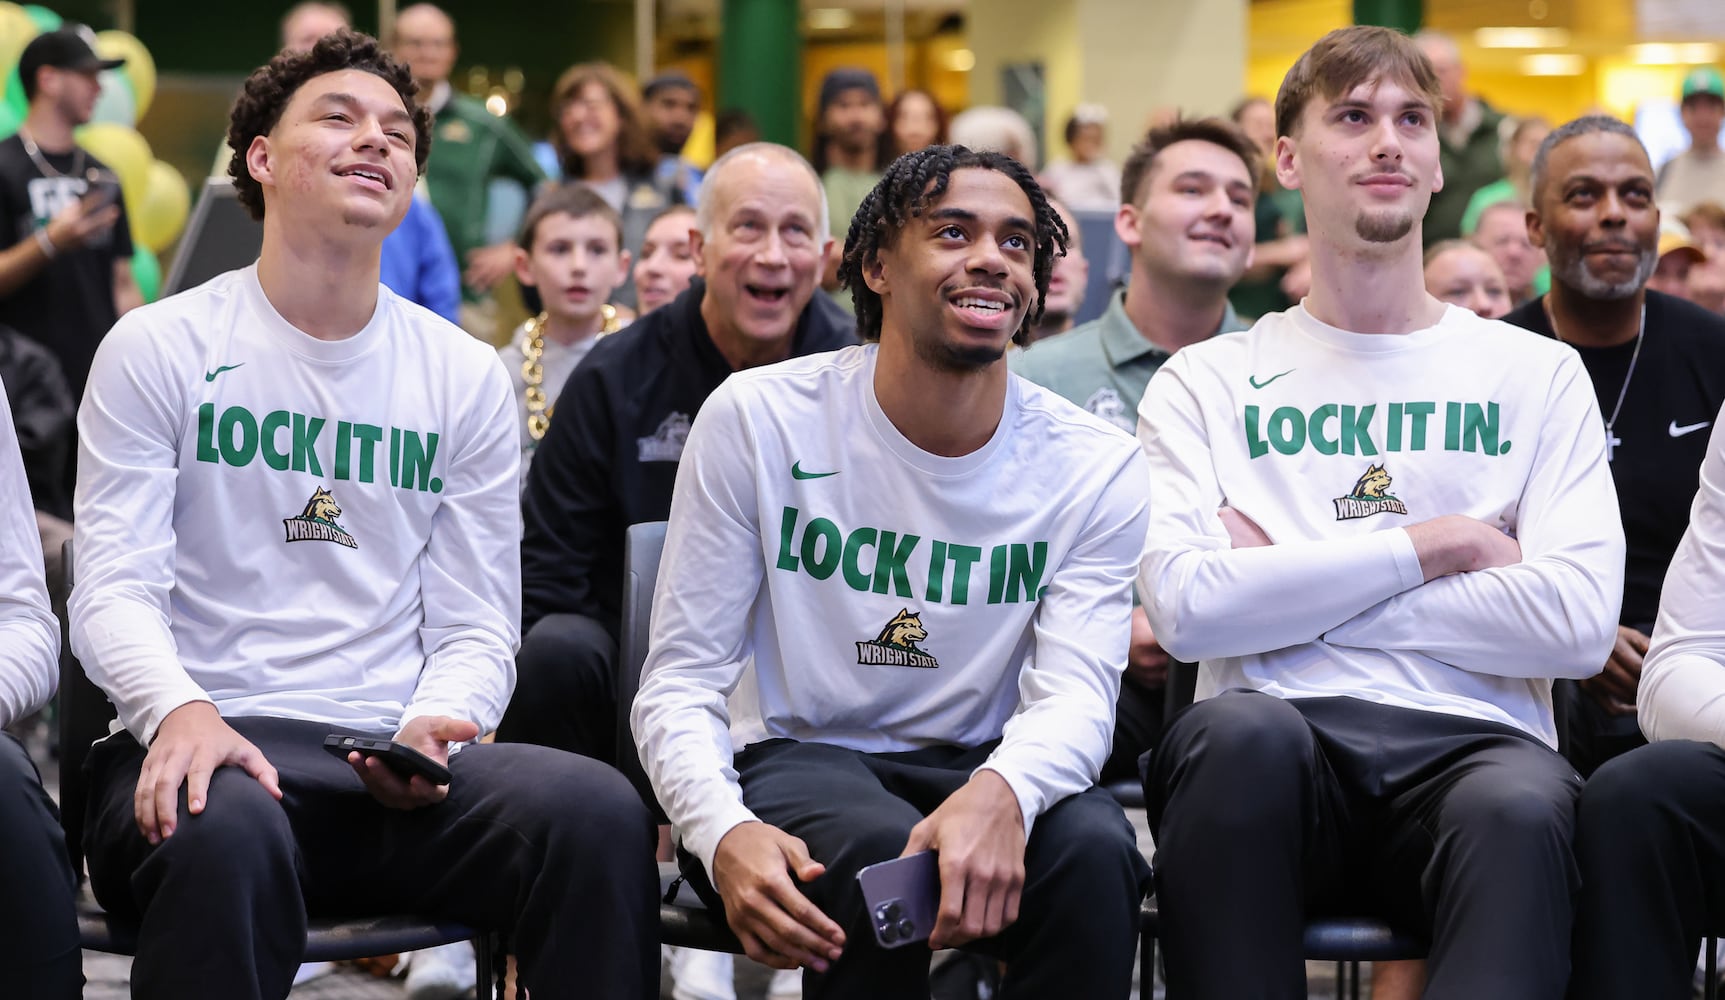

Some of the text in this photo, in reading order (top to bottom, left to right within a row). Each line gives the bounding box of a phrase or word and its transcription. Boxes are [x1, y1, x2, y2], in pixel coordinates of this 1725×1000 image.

[195, 403, 443, 493] LOCK IT IN.
[1246, 401, 1511, 459] LOCK IT IN.
[1335, 498, 1407, 519] WRIGHT STATE
[285, 519, 332, 541] WRIGHT
[776, 506, 920, 599] LOCK
[925, 539, 981, 605] IT
[858, 642, 939, 668] WRIGHT STATE
